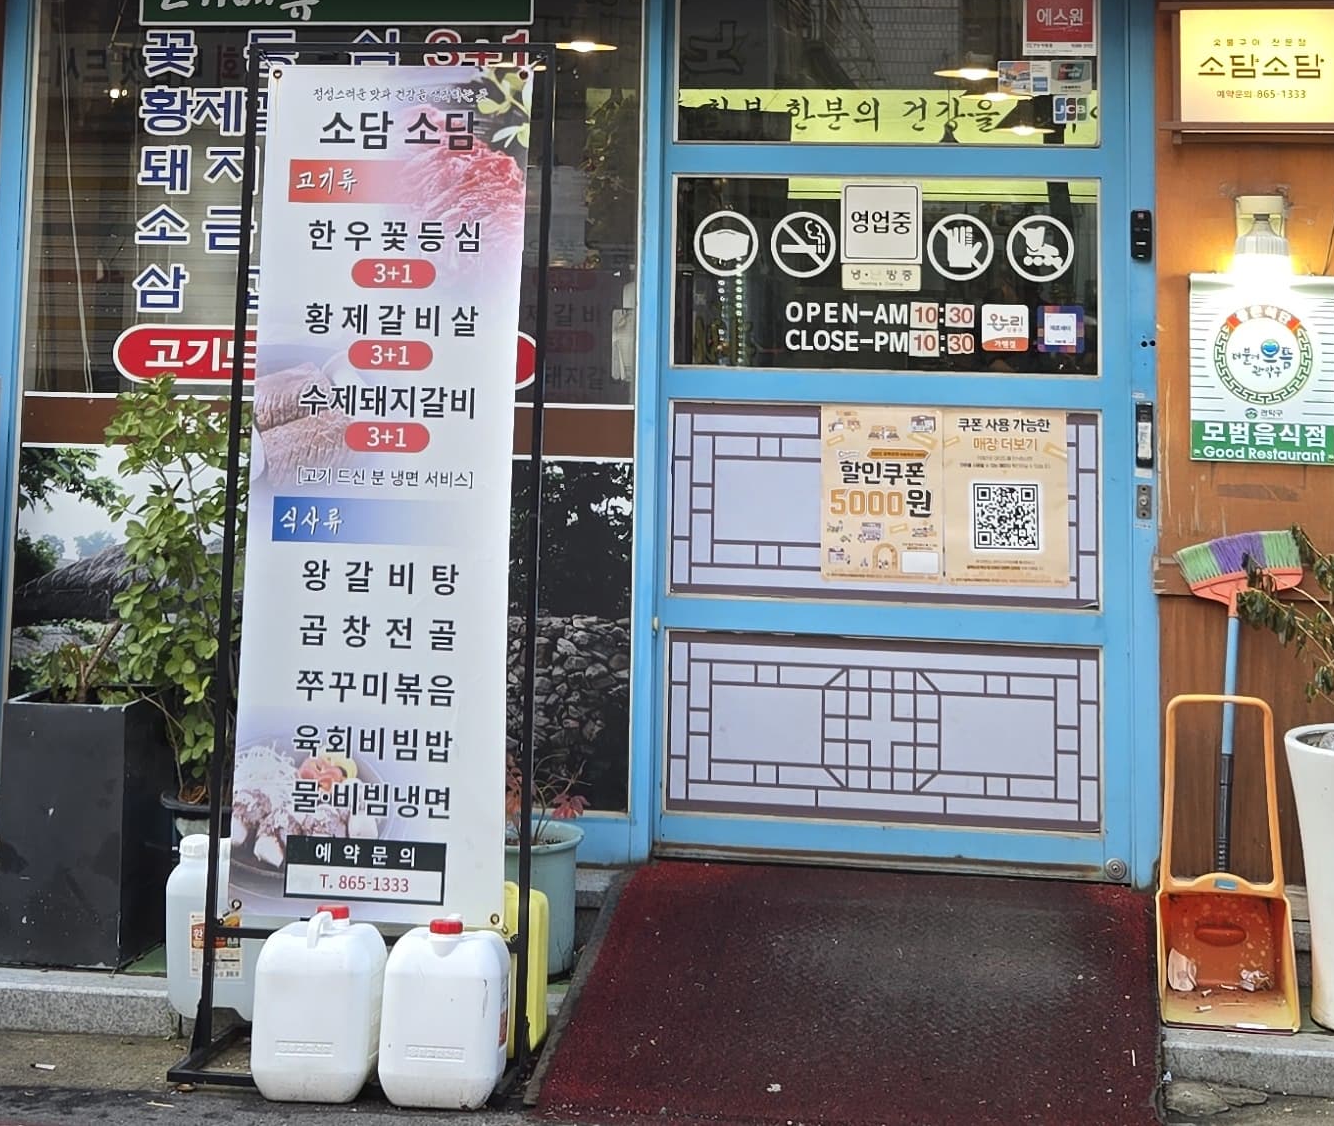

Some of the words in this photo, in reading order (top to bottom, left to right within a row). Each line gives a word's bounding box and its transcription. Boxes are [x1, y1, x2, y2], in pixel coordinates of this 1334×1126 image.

[1036, 8, 1084, 26] 에스원
[313, 87, 367, 102] 정성스러운
[370, 87, 392, 102] 맛과
[395, 88, 427, 103] 건강을
[1256, 90, 1307, 99] 865-1333
[1054, 104, 1086, 115] JCB
[319, 111, 394, 150] 소담
[404, 111, 481, 151] 소담
[295, 167, 358, 195] 고기류
[851, 210, 912, 235] 영업중
[308, 219, 481, 253] 한우꽃등심
[373, 263, 413, 283] 3+1
[305, 303, 480, 338] 황제갈비살
[986, 313, 1024, 331] 온누리
[370, 344, 410, 365] 3+1
[299, 384, 476, 419] 수제돼지갈비
[366, 426, 407, 448] 3+1
[958, 417, 983, 433] 쿠폰
[985, 418, 1011, 434] 사용
[1013, 418, 1051, 434] 가능한
[1202, 421, 1327, 448] 모범음식점
[972, 437, 998, 451] 매장
[1001, 437, 1038, 451] 더보기
[1202, 445, 1245, 459] Good
[1248, 446, 1326, 462] Restaurant
[337, 466, 366, 486] 드신
[370, 468, 386, 487] 분
[390, 468, 419, 488] 냉면
[839, 460, 926, 486] 할인쿠폰
[830, 488, 932, 518] 5000원
[279, 505, 343, 535] 식사류
[296, 670, 456, 707] 쭈꾸미볶음
[292, 724, 453, 763] 육회비빔밥
[314, 842, 417, 868] 예약문의
[319, 874, 335, 891] T.
[338, 875, 410, 893] 865-1333
